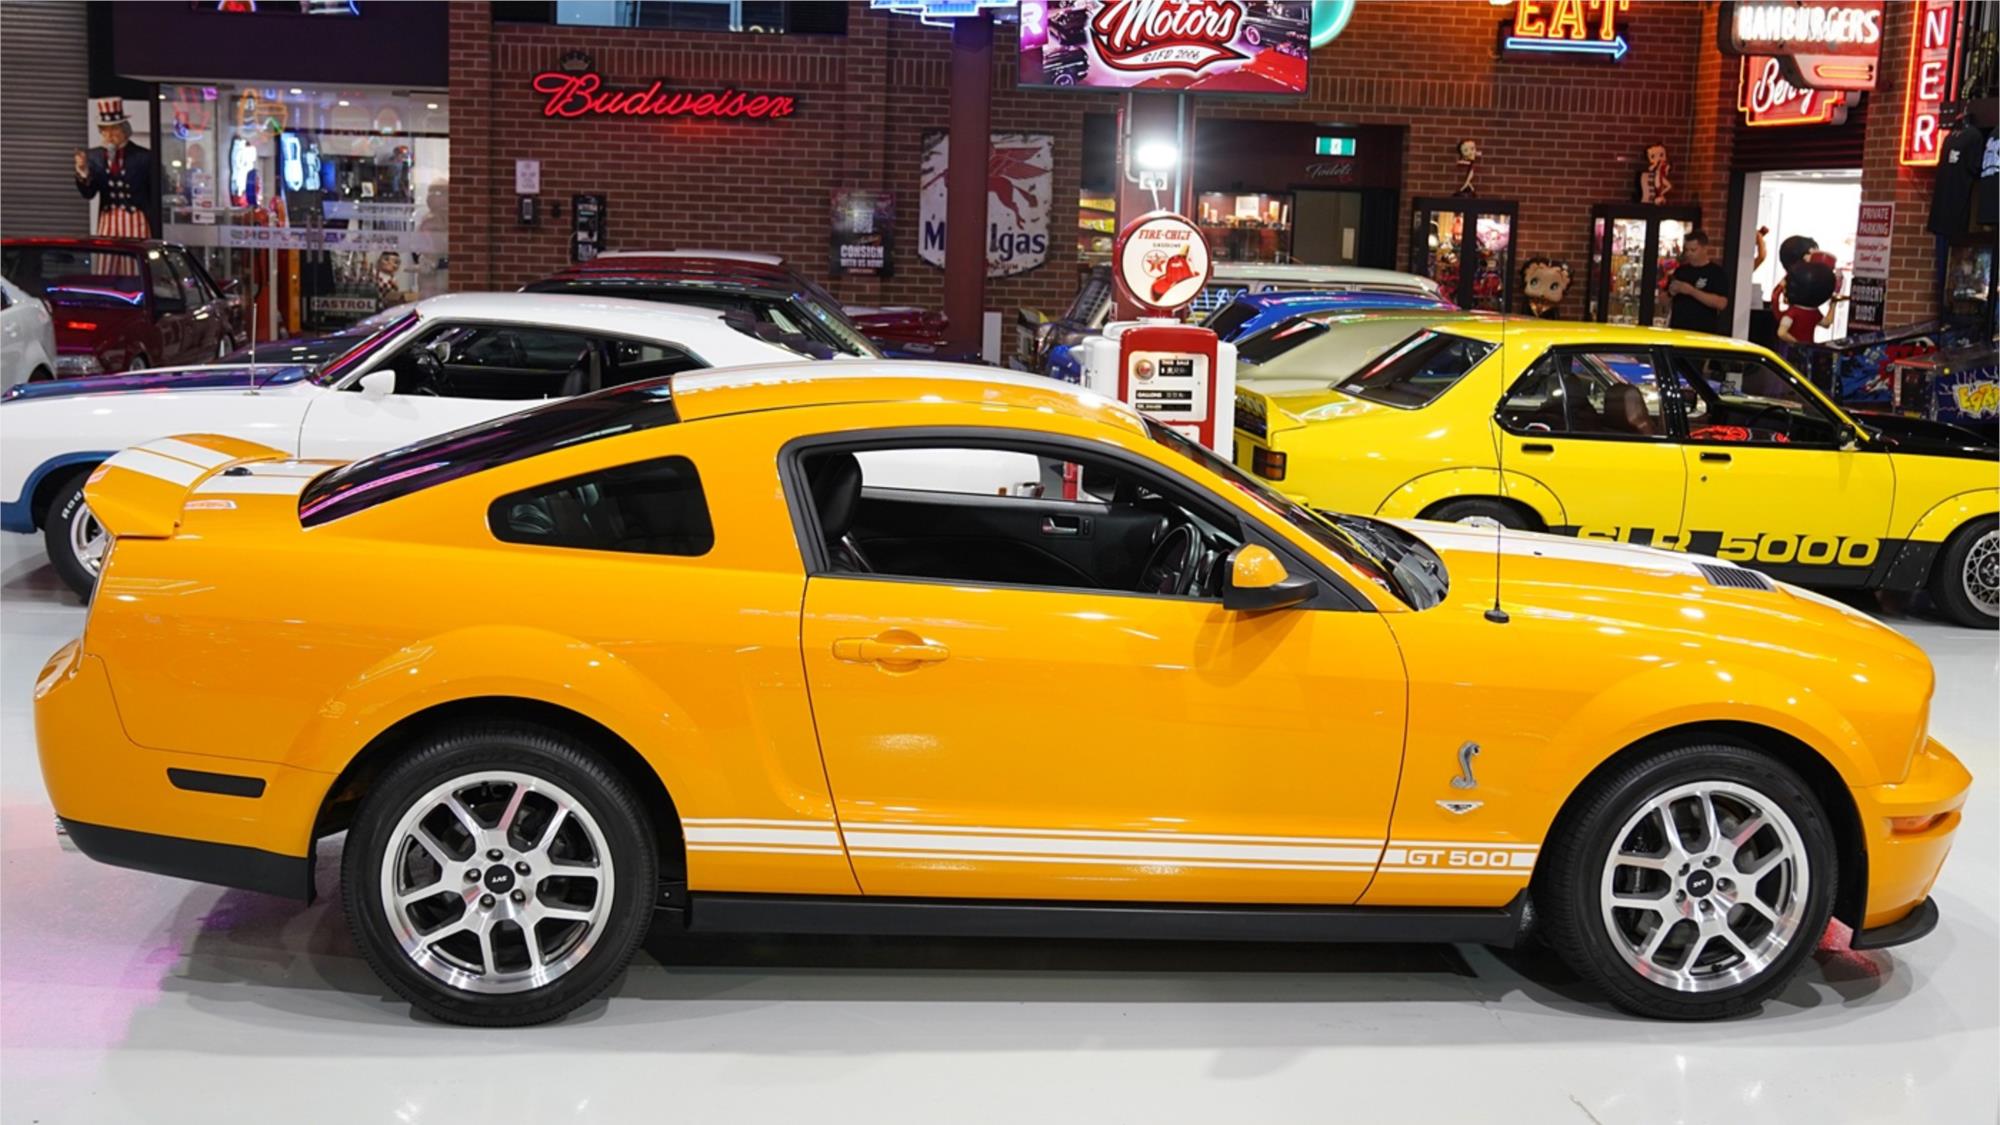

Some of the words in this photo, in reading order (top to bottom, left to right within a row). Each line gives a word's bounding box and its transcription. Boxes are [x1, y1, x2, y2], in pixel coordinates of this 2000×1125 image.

[1101, 0, 1234, 49] Motors
[1514, 1, 1629, 41] EAT
[1738, 5, 1880, 44] HAMBURGERS
[533, 72, 795, 118] Budweiser
[840, 244, 884, 258] CONSIGN
[924, 221, 1046, 262] Mlgas
[1716, 531, 1880, 567] 5000
[1408, 850, 1445, 865] GT
[1448, 850, 1510, 868] 500
